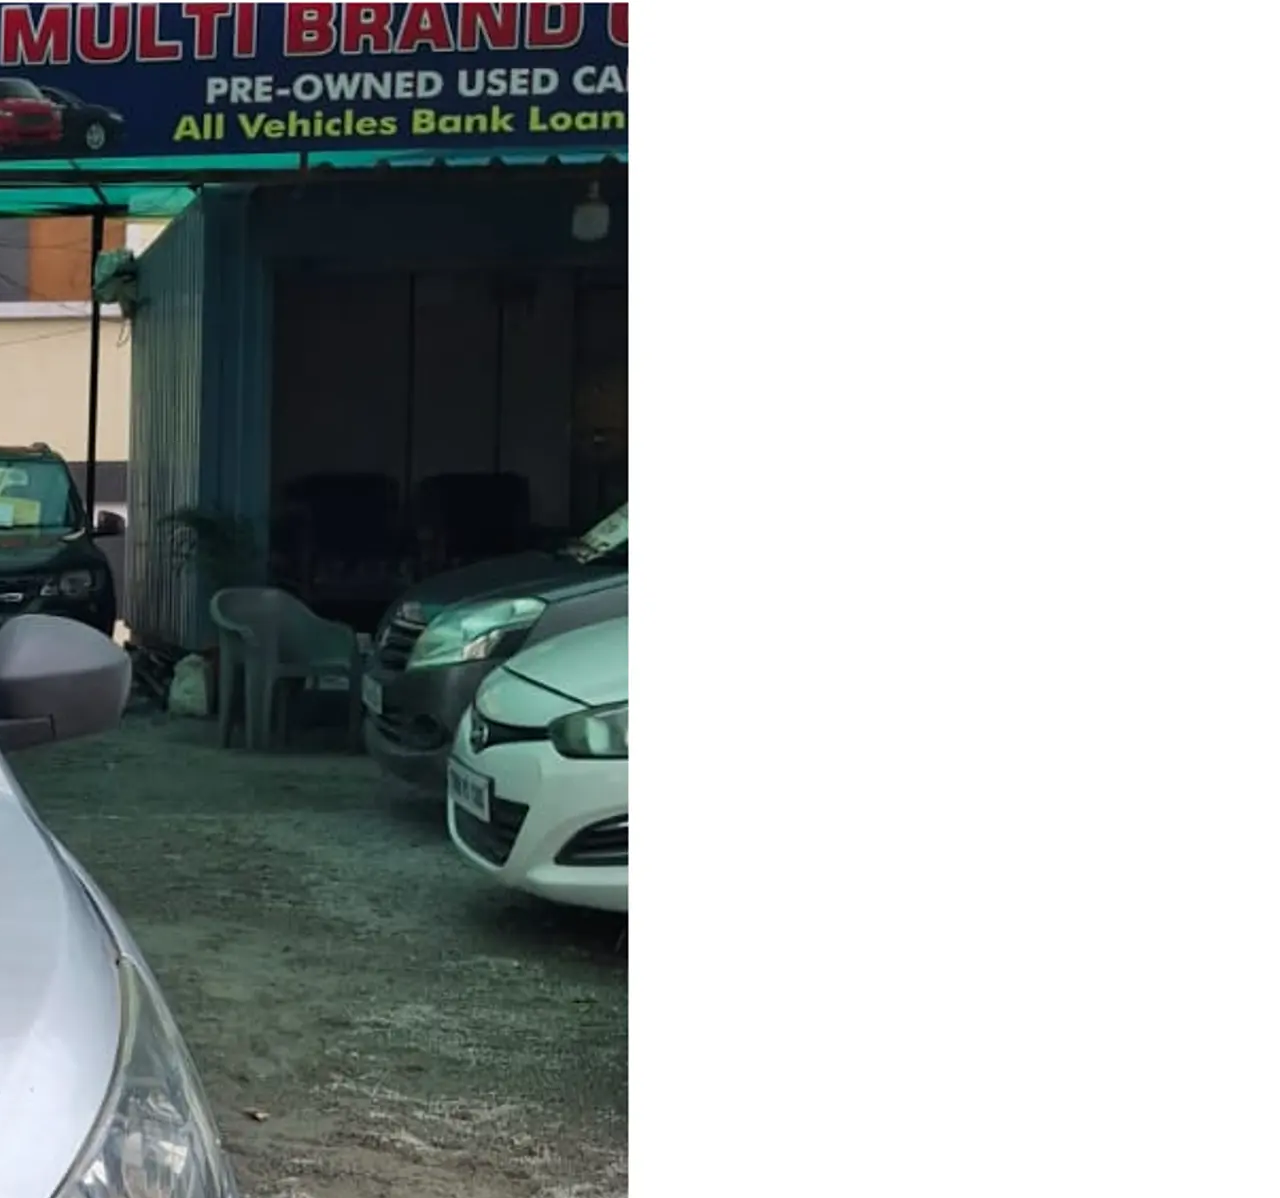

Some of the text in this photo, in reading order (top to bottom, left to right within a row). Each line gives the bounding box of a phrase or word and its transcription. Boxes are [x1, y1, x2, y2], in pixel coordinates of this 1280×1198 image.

[0, 3, 257, 66] MULTI
[283, 3, 585, 57] BRAND
[206, 71, 444, 104] PRE-OWNED
[457, 67, 560, 97] USED
[172, 105, 625, 141] All Vehicles Bank Loan
